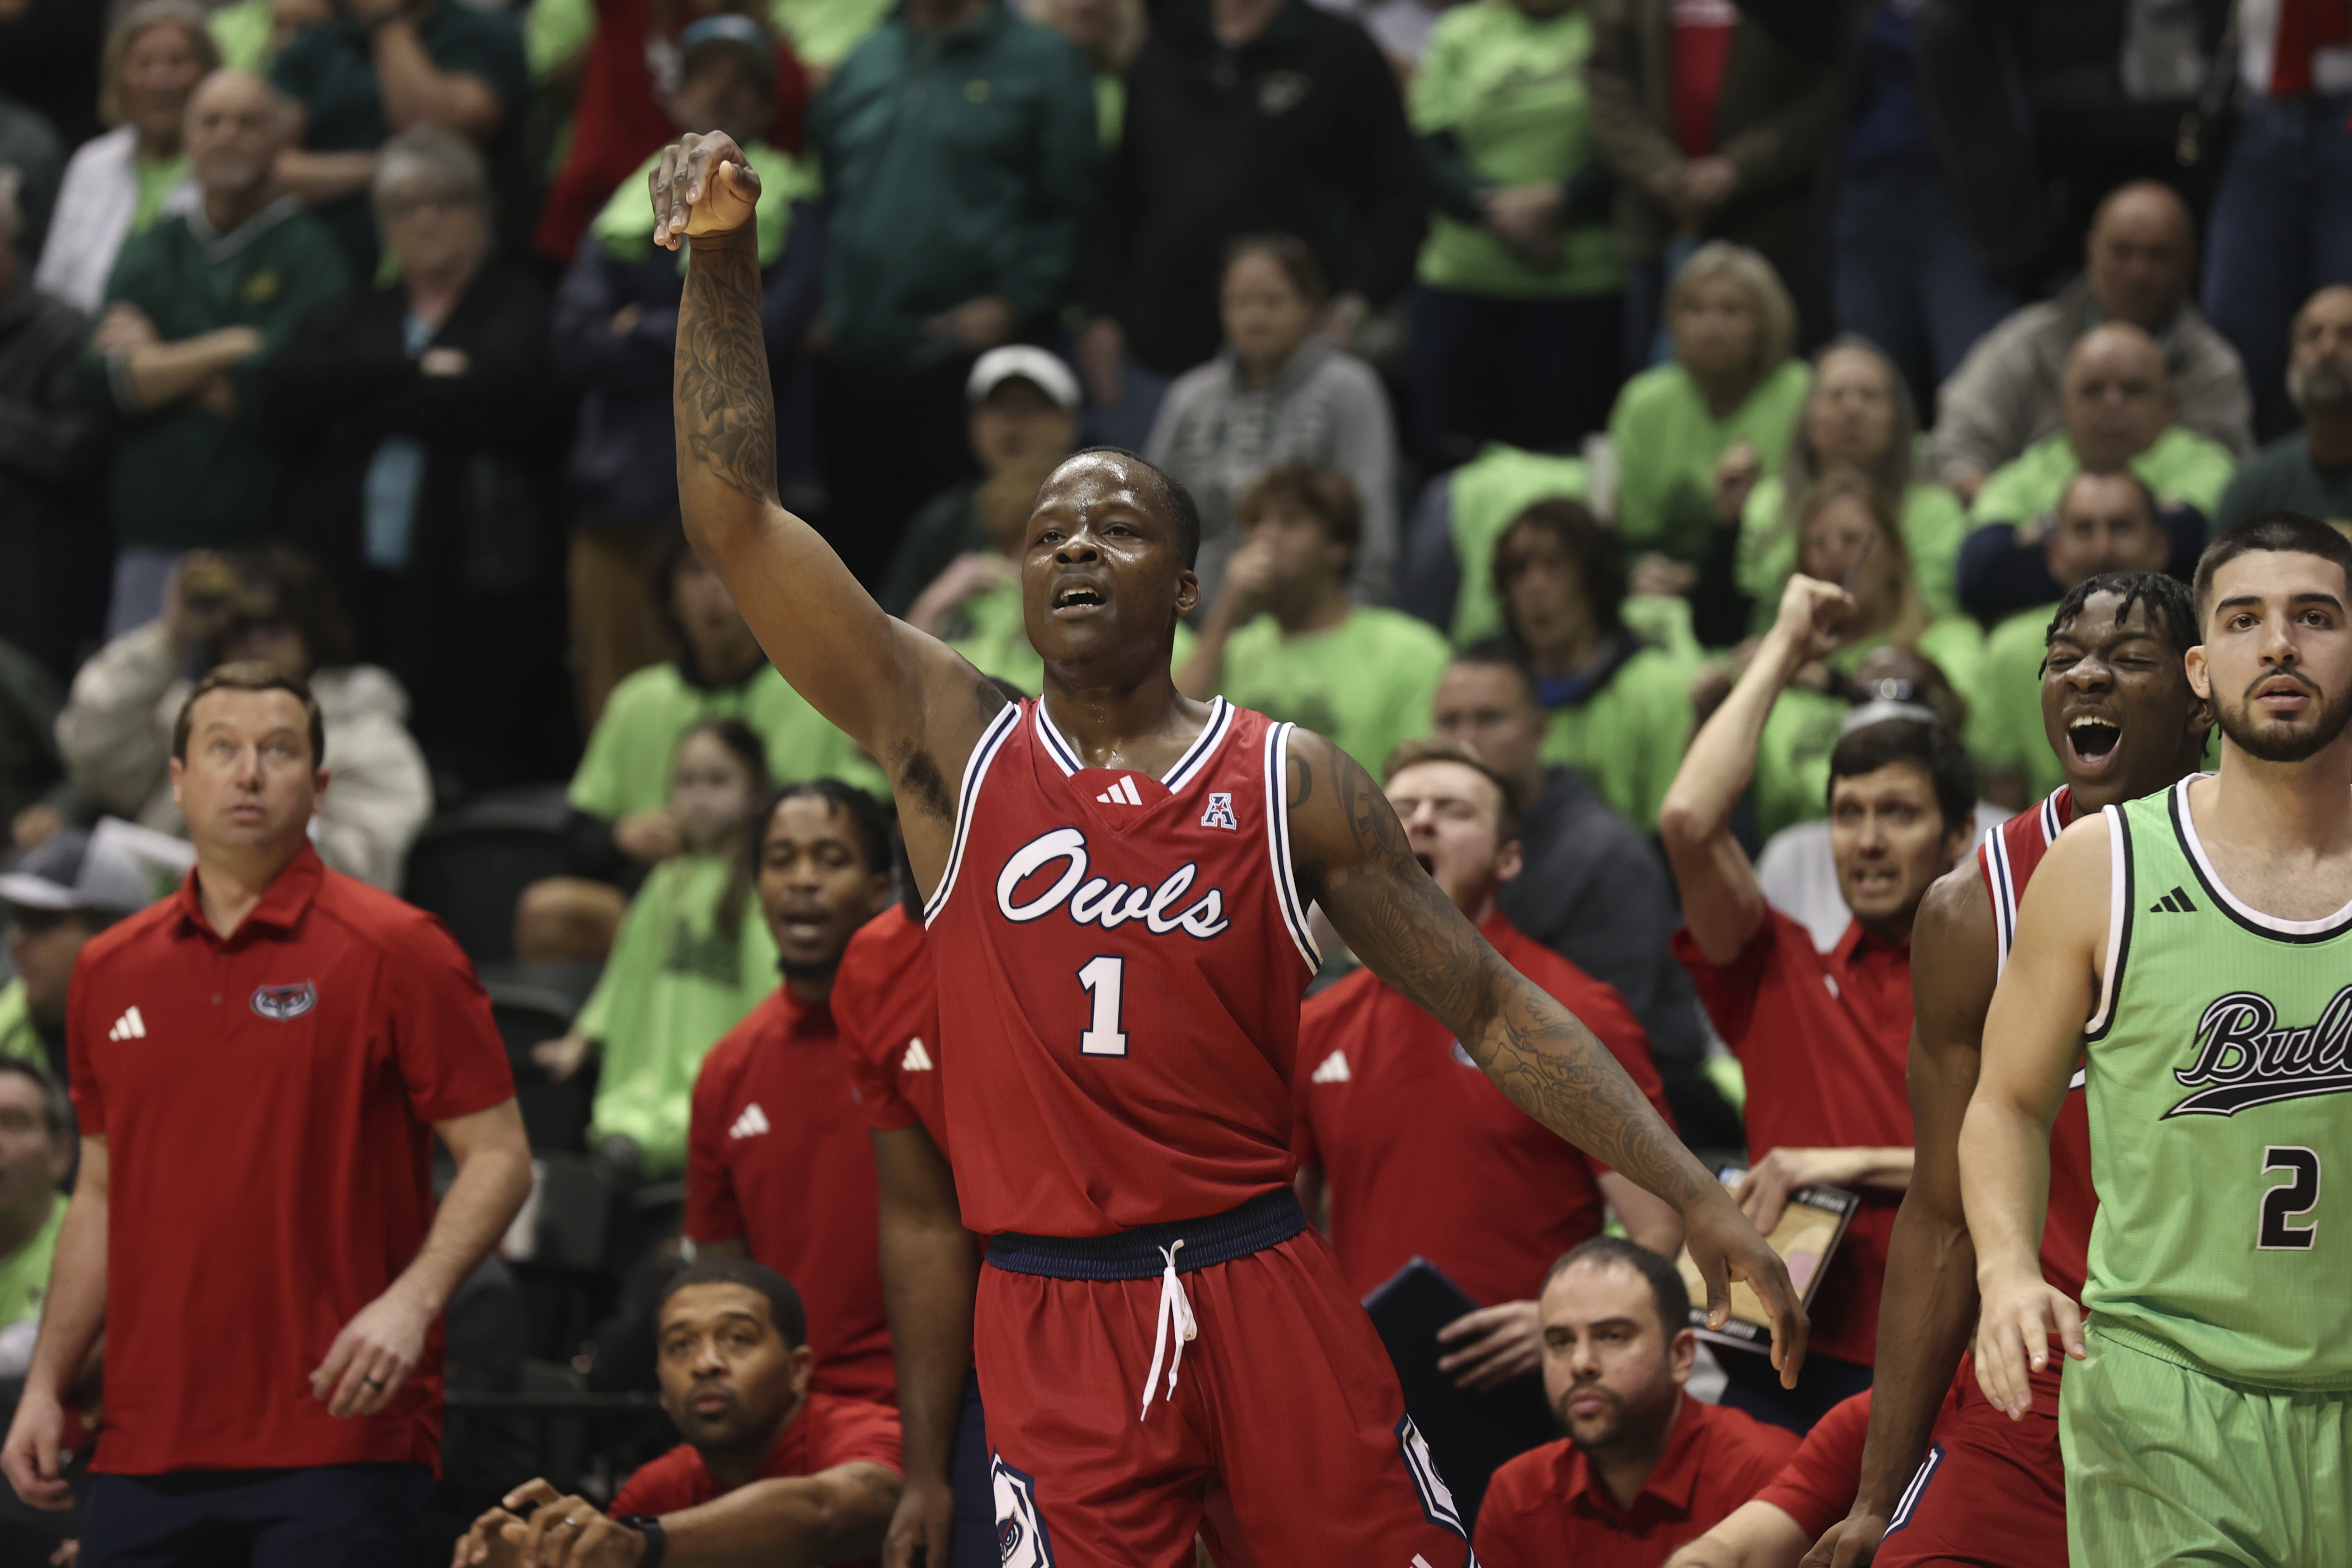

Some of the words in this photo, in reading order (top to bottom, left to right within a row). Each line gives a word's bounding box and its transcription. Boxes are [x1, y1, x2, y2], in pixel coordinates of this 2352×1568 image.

[996, 825, 1230, 940] Owls
[1075, 954, 1129, 1058] 1
[2256, 1145, 2321, 1251] 2
